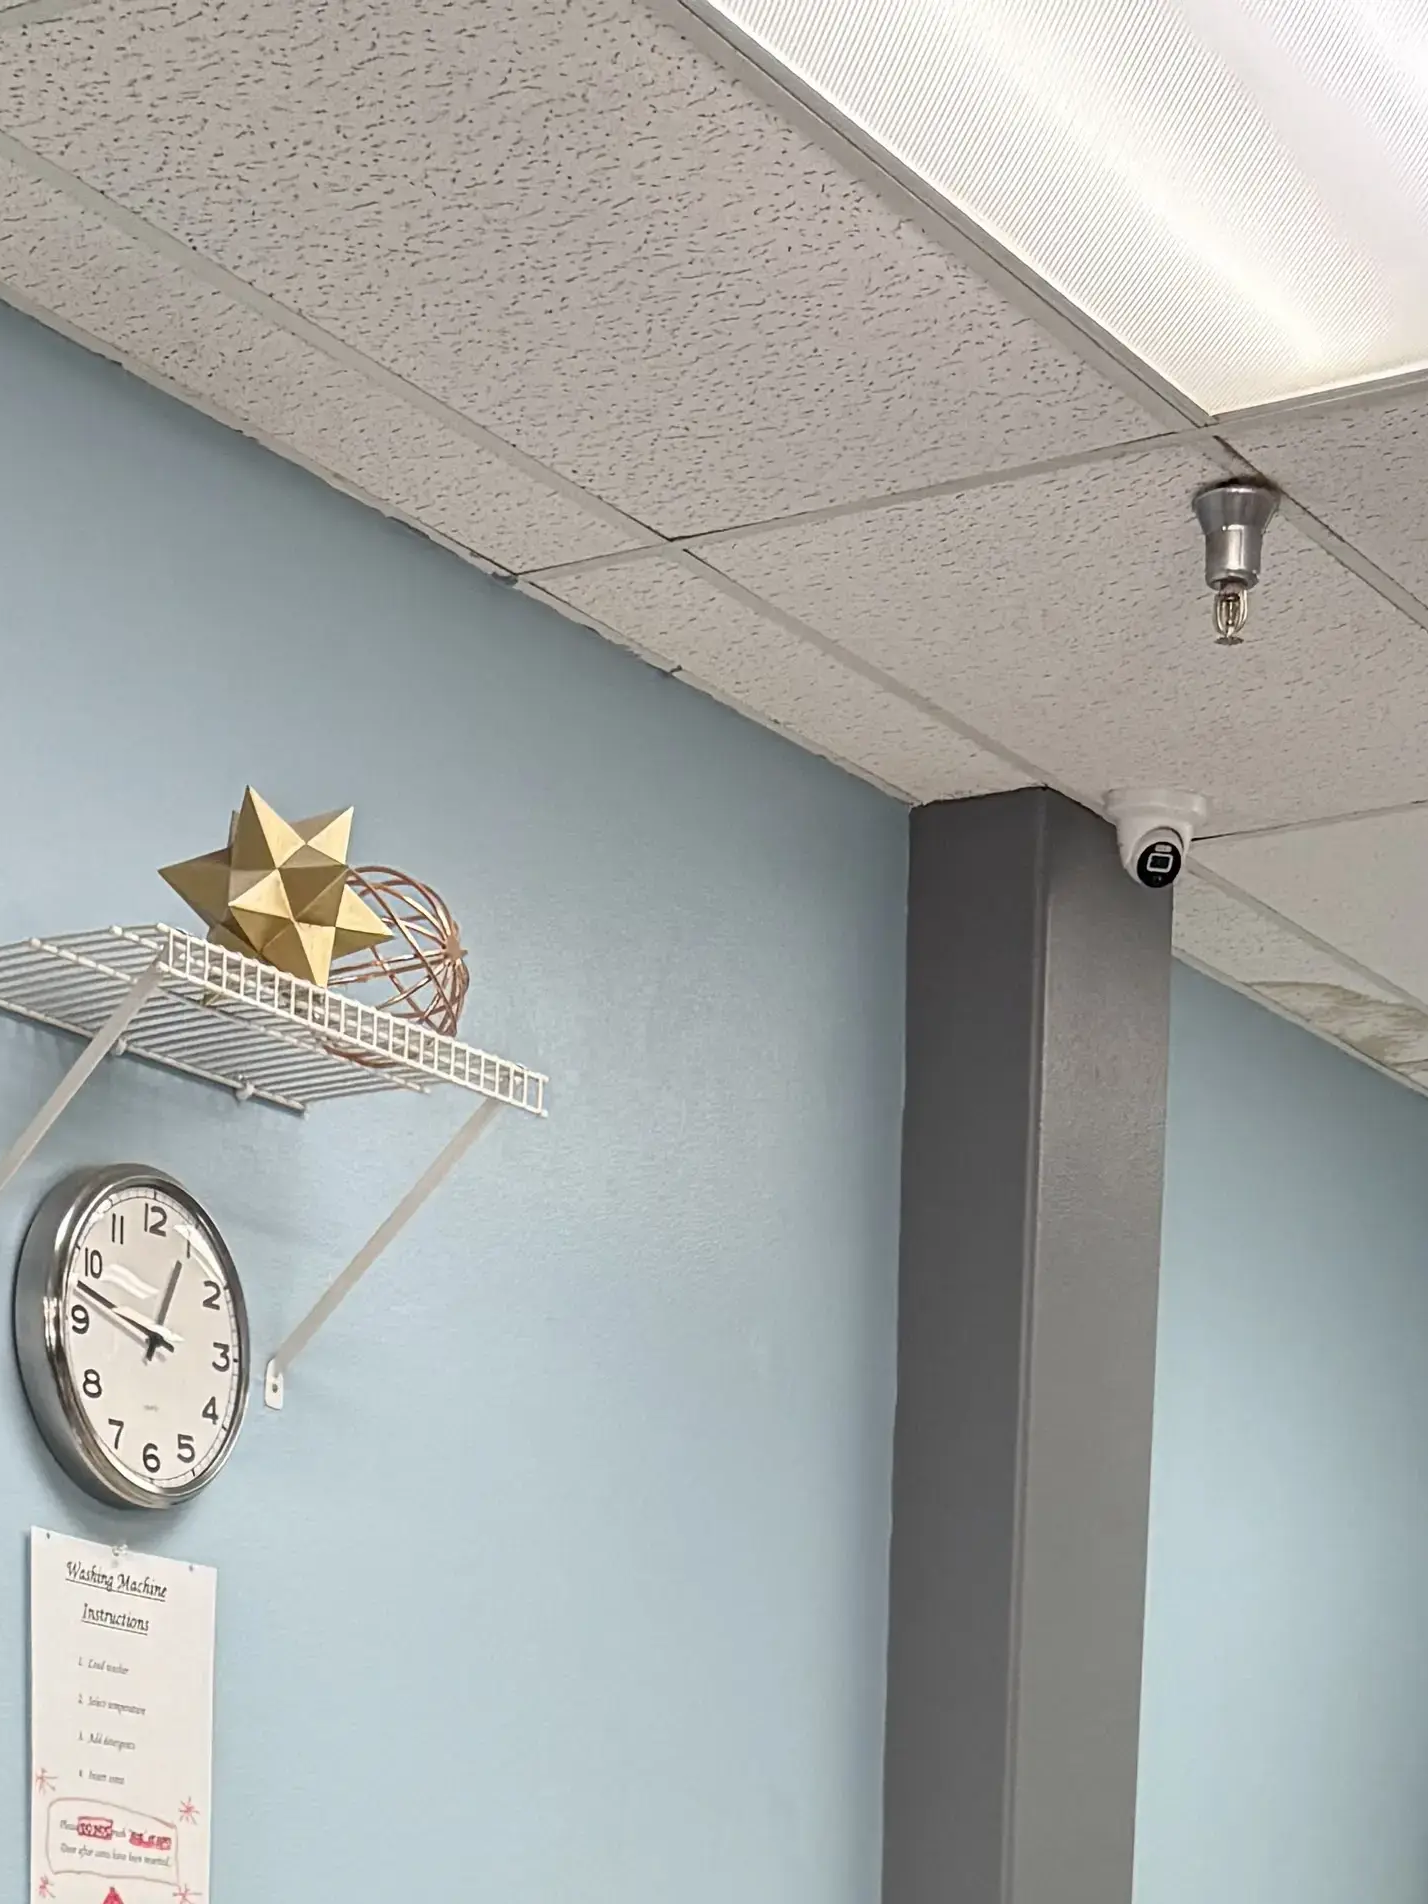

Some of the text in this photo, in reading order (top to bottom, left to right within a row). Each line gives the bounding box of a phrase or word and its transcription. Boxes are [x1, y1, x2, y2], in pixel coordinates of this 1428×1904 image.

[112, 1213, 124, 1245] 11
[144, 1203, 168, 1237] 12
[85, 1247, 103, 1279] 10
[202, 1280, 221, 1310] 2
[72, 1304, 89, 1335] 9
[212, 1341, 230, 1372] 3
[82, 1368, 102, 1399] 8
[202, 1396, 218, 1425] 4
[108, 1418, 124, 1450] 7
[177, 1433, 195, 1463] 5
[142, 1443, 161, 1473] 6
[66, 1561, 167, 1598] Washing Machine
[82, 1602, 149, 1632] Instructions
